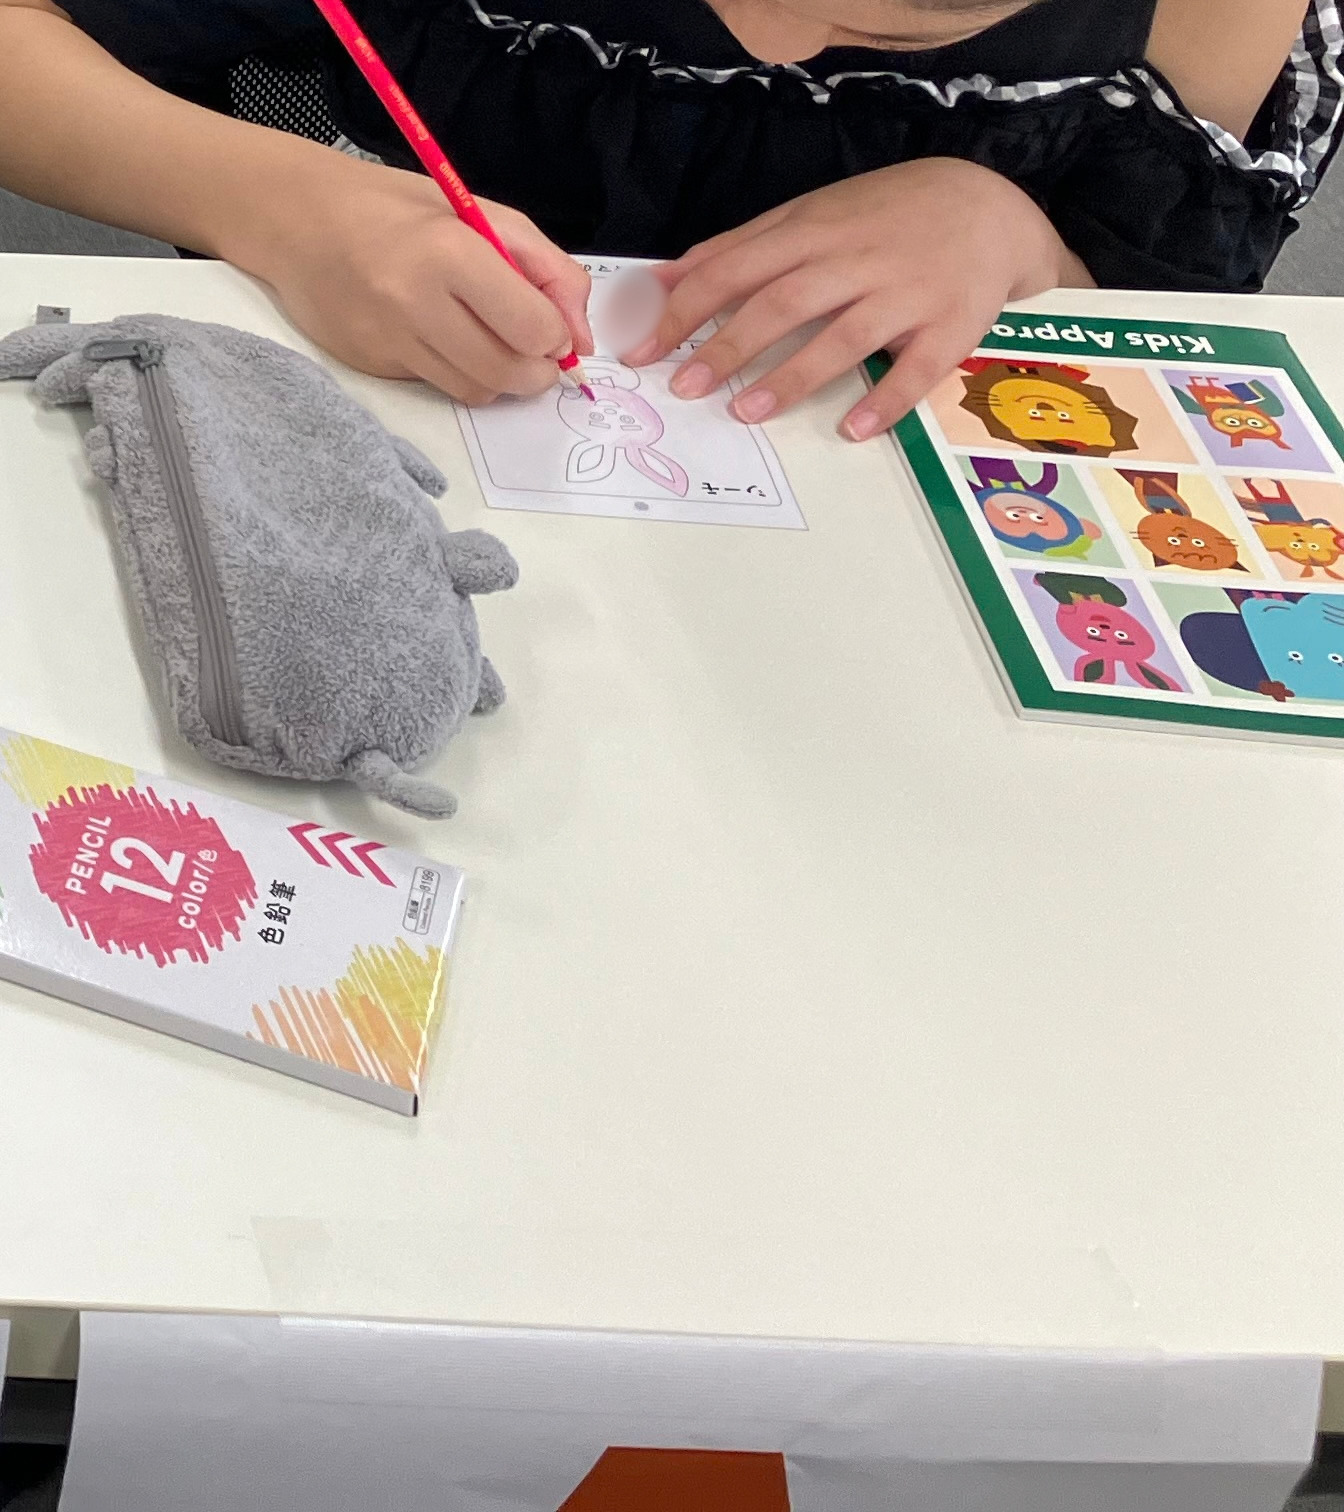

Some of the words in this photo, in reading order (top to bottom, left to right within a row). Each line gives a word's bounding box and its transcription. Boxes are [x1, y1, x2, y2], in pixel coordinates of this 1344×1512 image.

[984, 322, 1115, 350] Appro
[1124, 331, 1216, 356] Kids
[65, 816, 112, 895] PENCIL
[99, 836, 186, 904] 12
[178, 849, 218, 930] color/色
[257, 879, 297, 945] 色鉛筆
